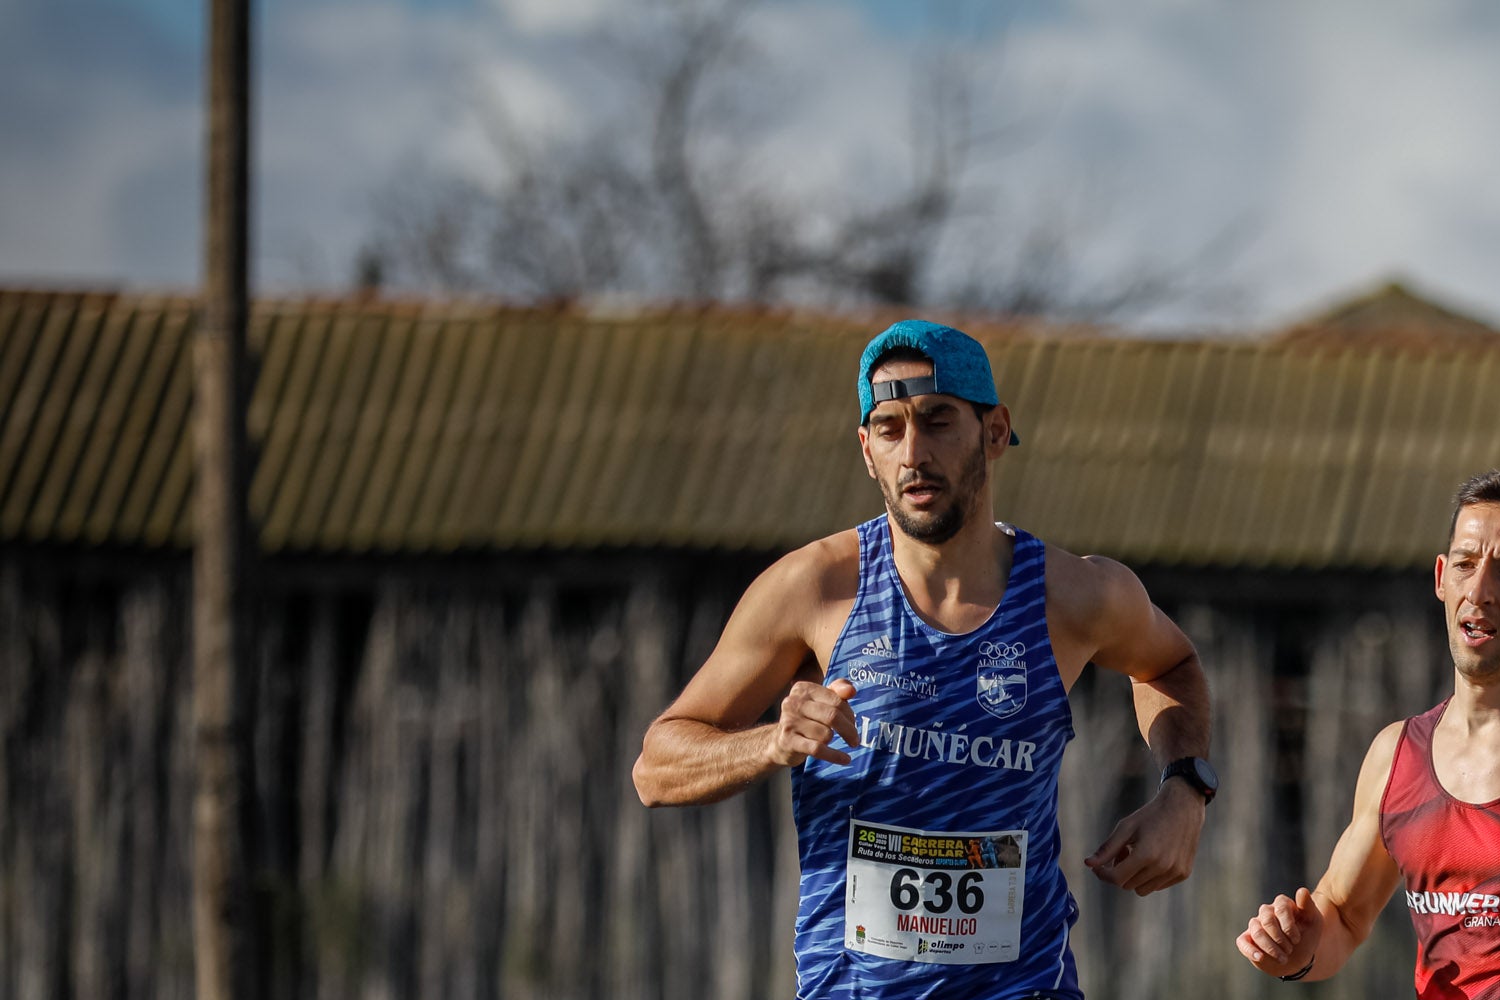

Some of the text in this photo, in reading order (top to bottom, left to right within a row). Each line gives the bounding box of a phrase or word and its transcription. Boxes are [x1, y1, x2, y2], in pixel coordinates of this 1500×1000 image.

[862, 647, 898, 659] adidas
[849, 668, 939, 697] CONTINENTAL
[854, 713, 1037, 772] LMUÑÉCAR
[859, 829, 876, 842] 26
[888, 834, 964, 852] VII CARRERA
[857, 846, 874, 857] Ruta
[874, 850, 884, 858] de
[884, 851, 896, 860] los
[898, 853, 934, 866] Secaderos
[901, 845, 964, 858] POPULAR
[890, 868, 985, 914] 636
[897, 914, 977, 936] MANUELICO
[931, 939, 965, 951] olimpo
